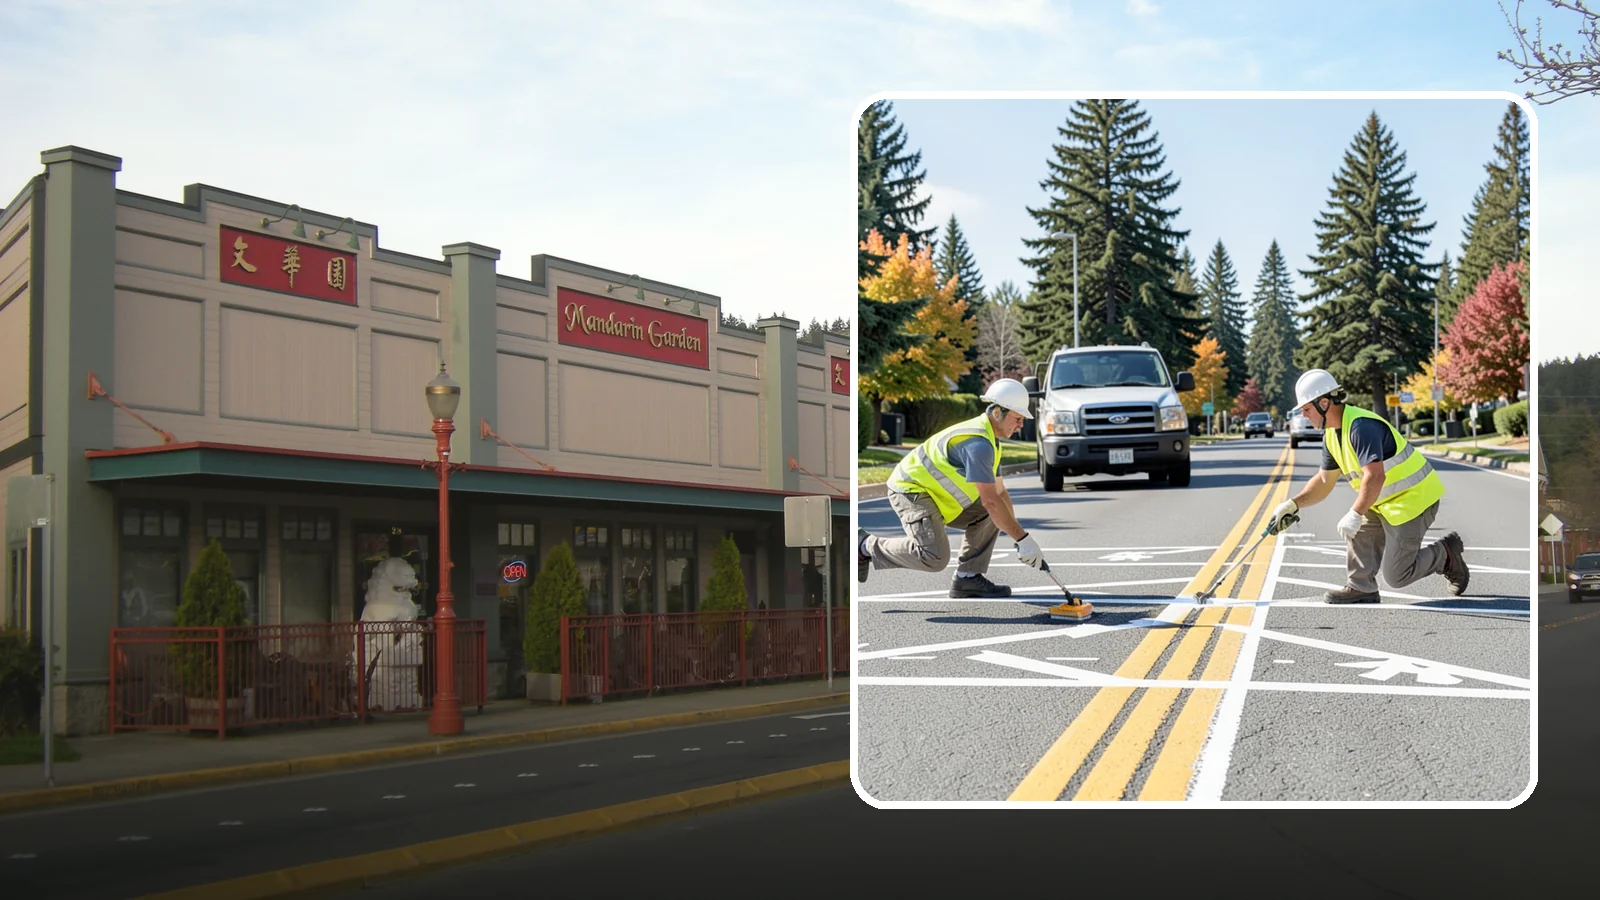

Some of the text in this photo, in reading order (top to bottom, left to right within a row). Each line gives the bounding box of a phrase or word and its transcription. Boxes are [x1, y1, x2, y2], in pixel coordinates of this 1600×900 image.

[231, 235, 346, 290] 文華園
[564, 302, 701, 352] Mandarin Garden
[503, 565, 527, 578] OPEN
